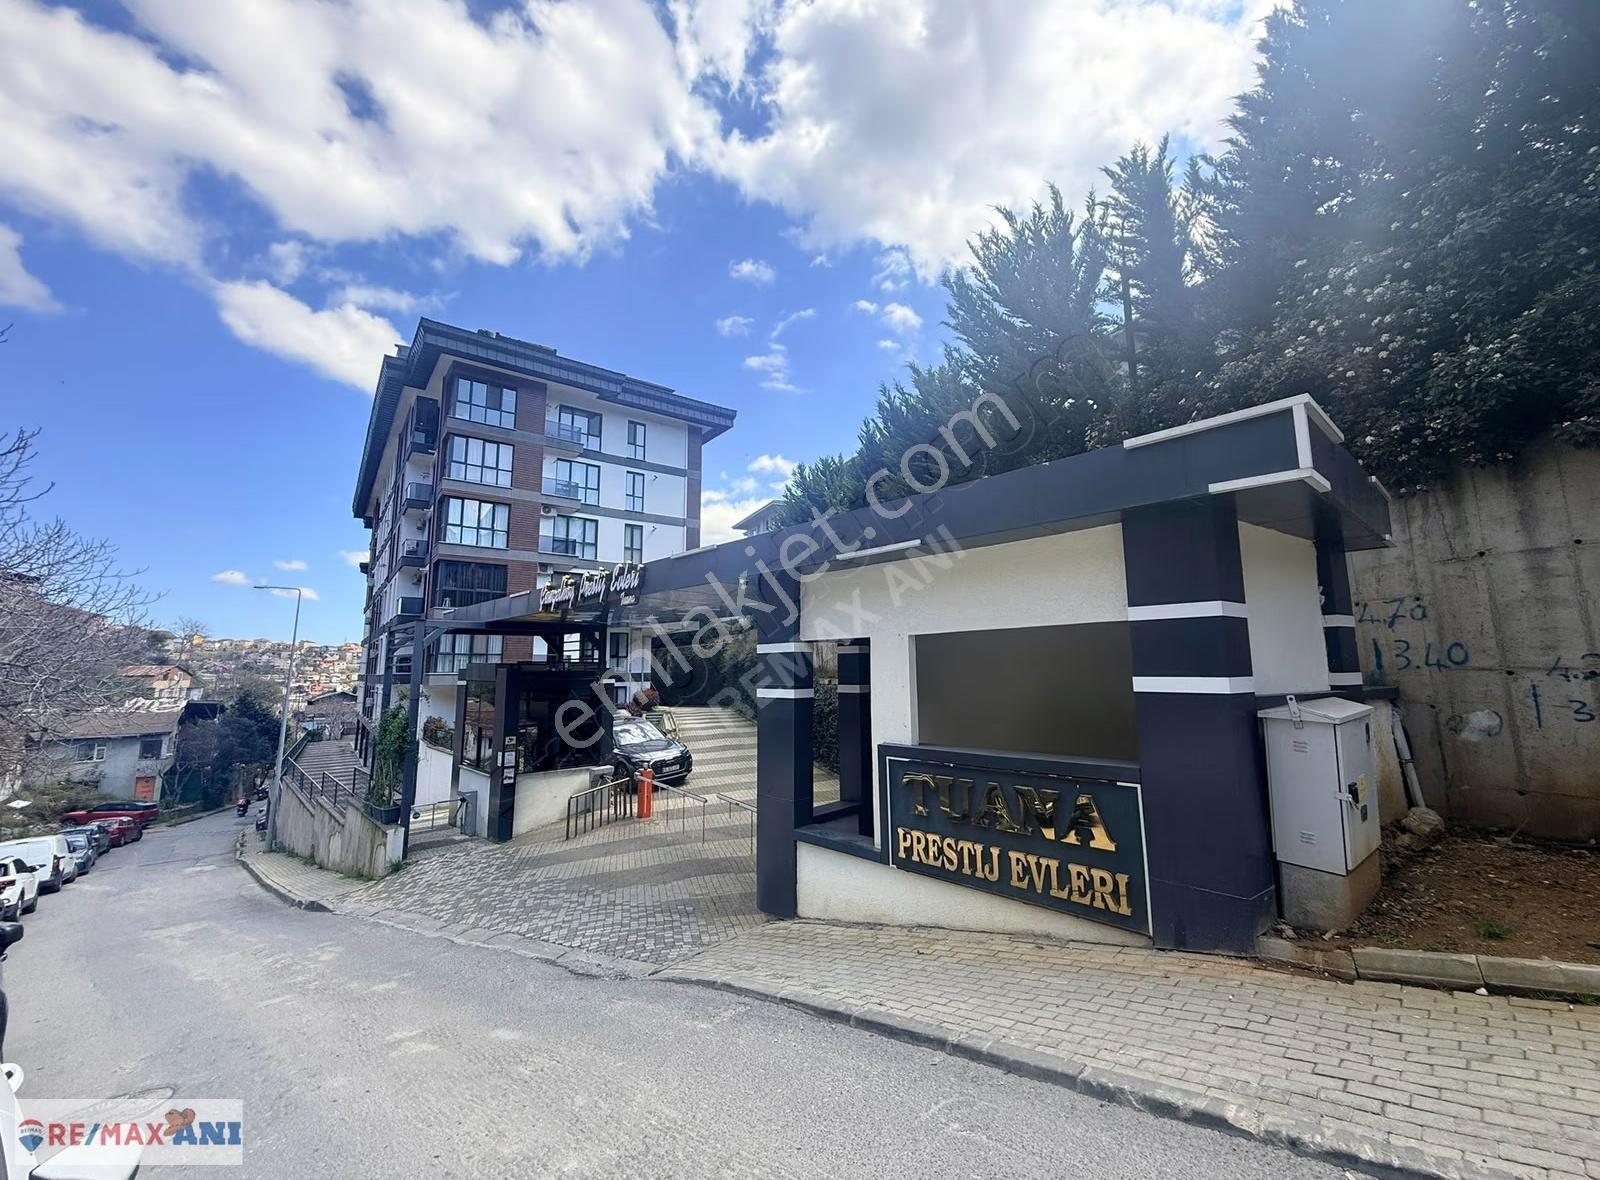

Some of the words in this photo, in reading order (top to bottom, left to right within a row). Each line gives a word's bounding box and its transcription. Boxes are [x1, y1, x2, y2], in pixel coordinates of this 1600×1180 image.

[901, 771, 1117, 852] TUANA
[897, 826, 1001, 882] PRESTIJ
[1008, 850, 1132, 916] EVLERI
